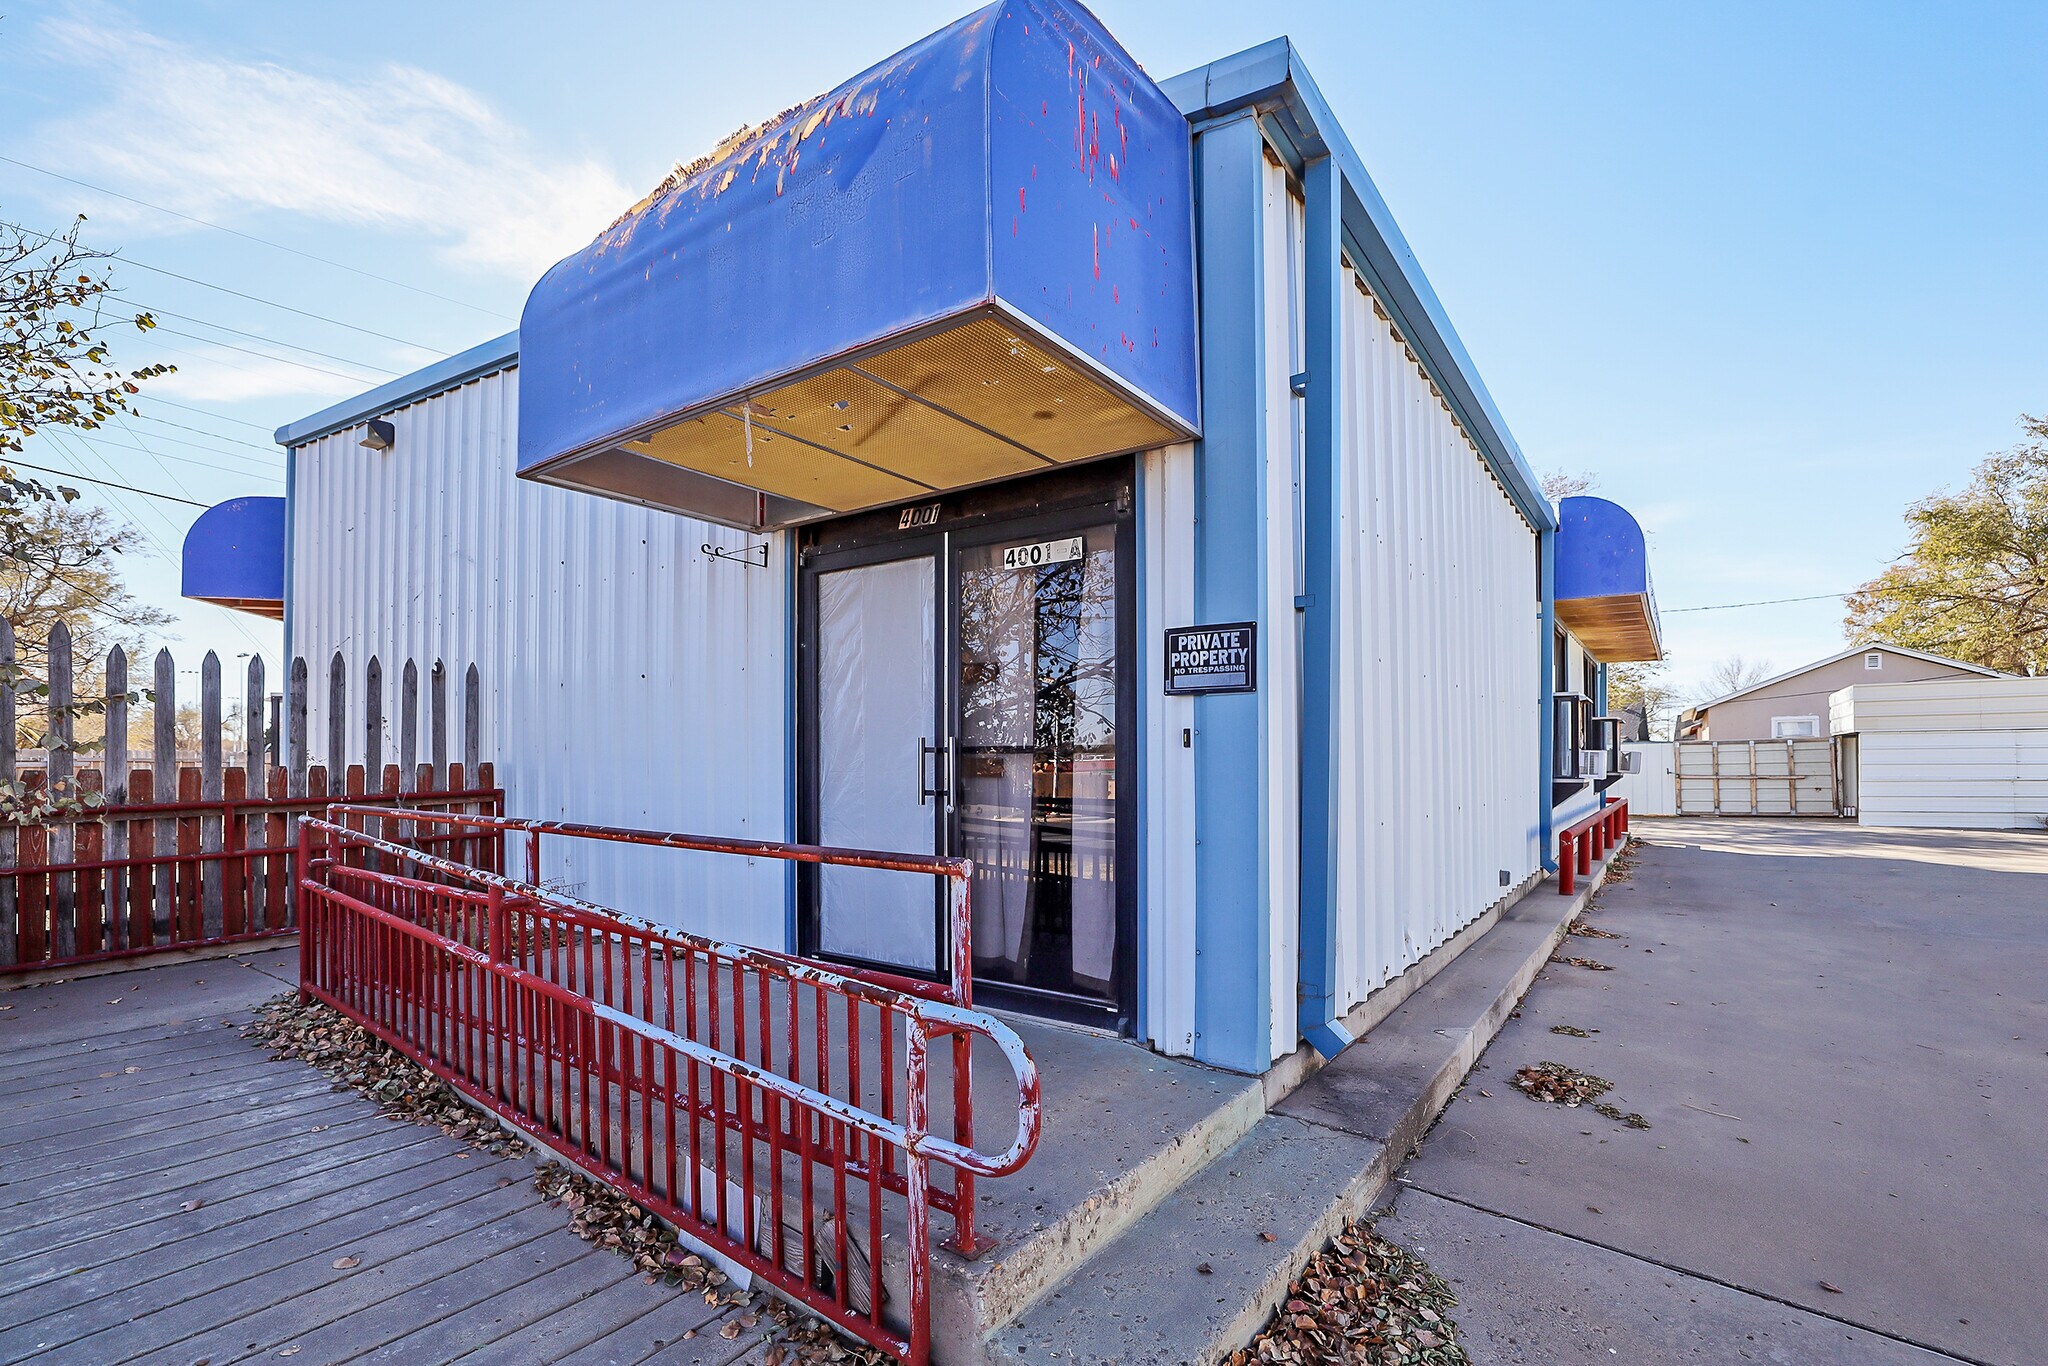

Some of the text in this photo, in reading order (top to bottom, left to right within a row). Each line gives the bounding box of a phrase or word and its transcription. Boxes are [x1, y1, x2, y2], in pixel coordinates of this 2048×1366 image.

[900, 504, 940, 527] 4001
[1178, 632, 1240, 651] PRIVATE
[1171, 648, 1248, 667] PROPERTY
[1187, 664, 1246, 674] TRESPASSING
